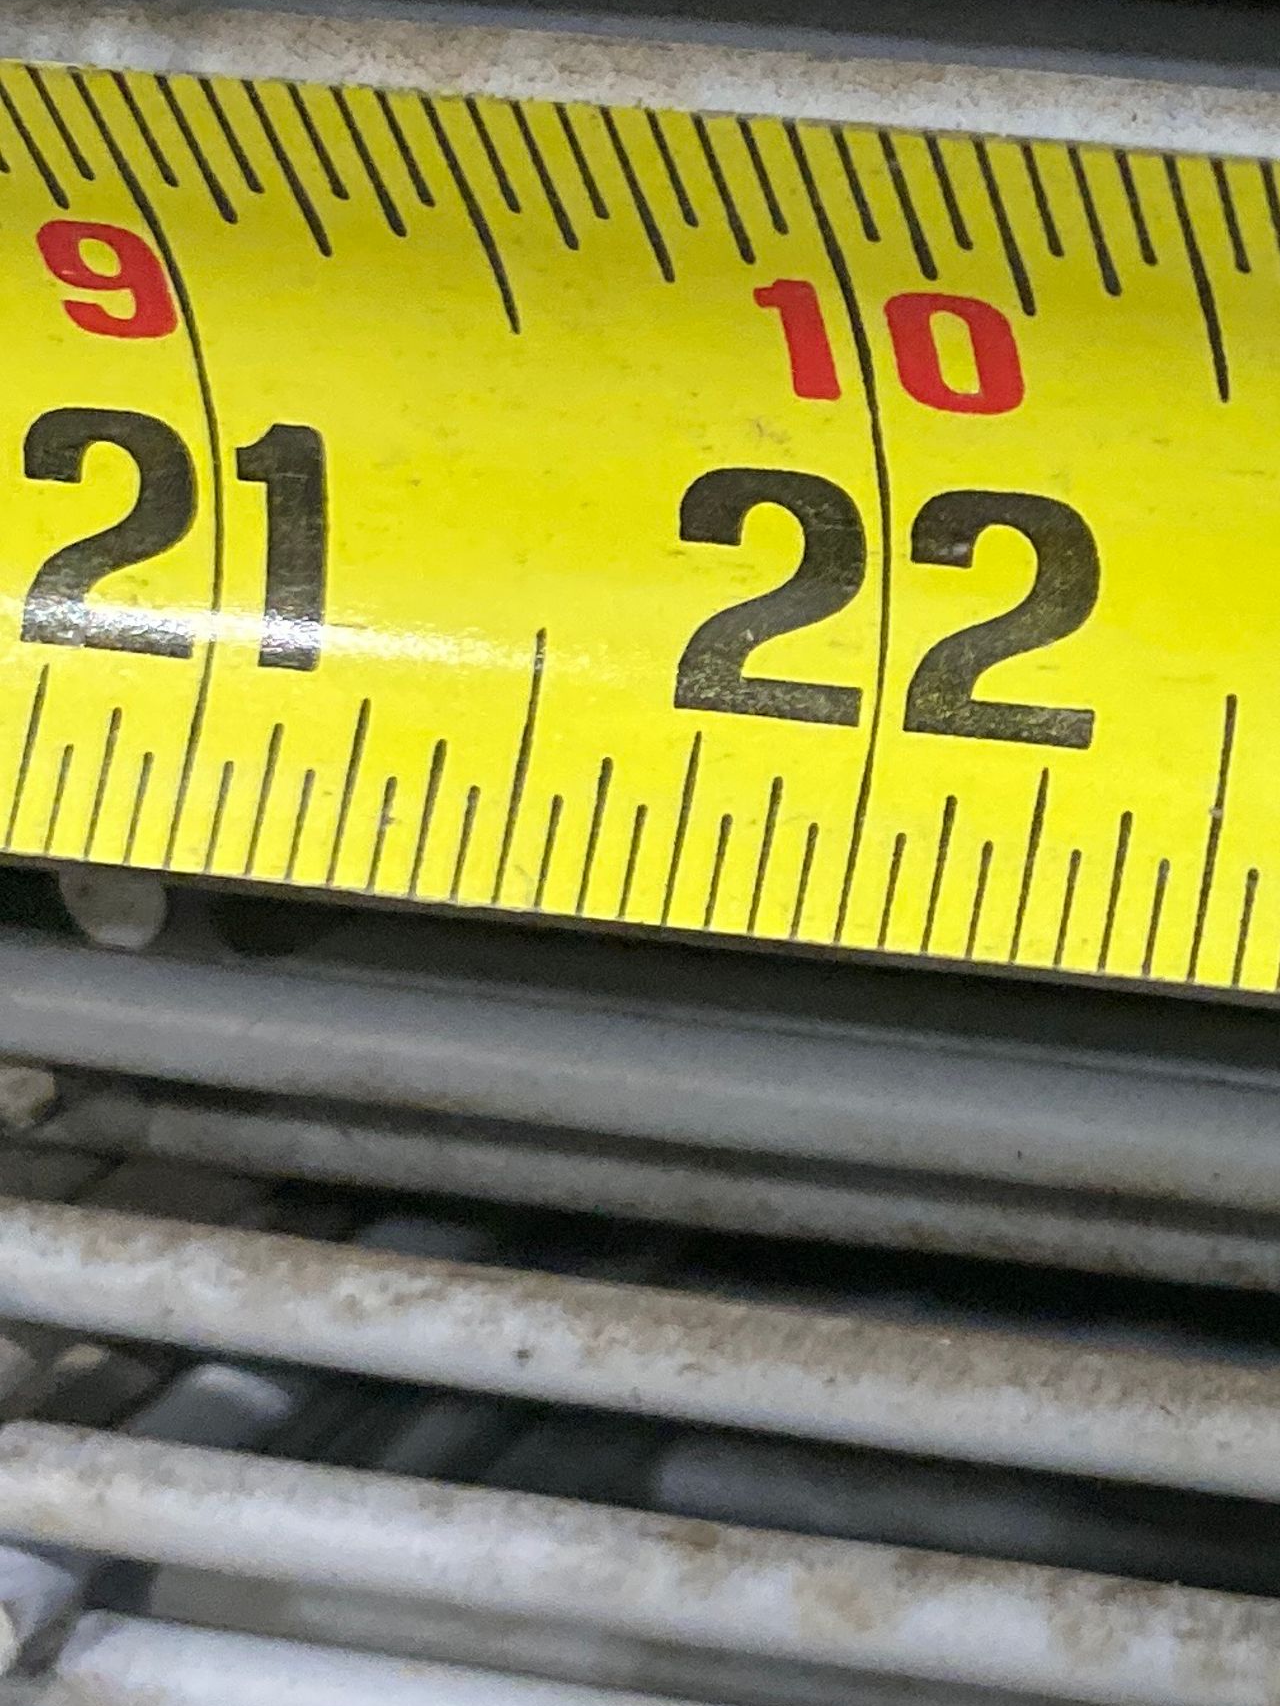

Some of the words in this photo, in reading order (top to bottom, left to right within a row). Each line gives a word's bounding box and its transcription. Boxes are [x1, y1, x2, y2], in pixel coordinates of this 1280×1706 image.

[37, 221, 178, 338] 9
[755, 279, 1024, 414] 10
[20, 407, 326, 671] 21
[674, 467, 1100, 750] 22
